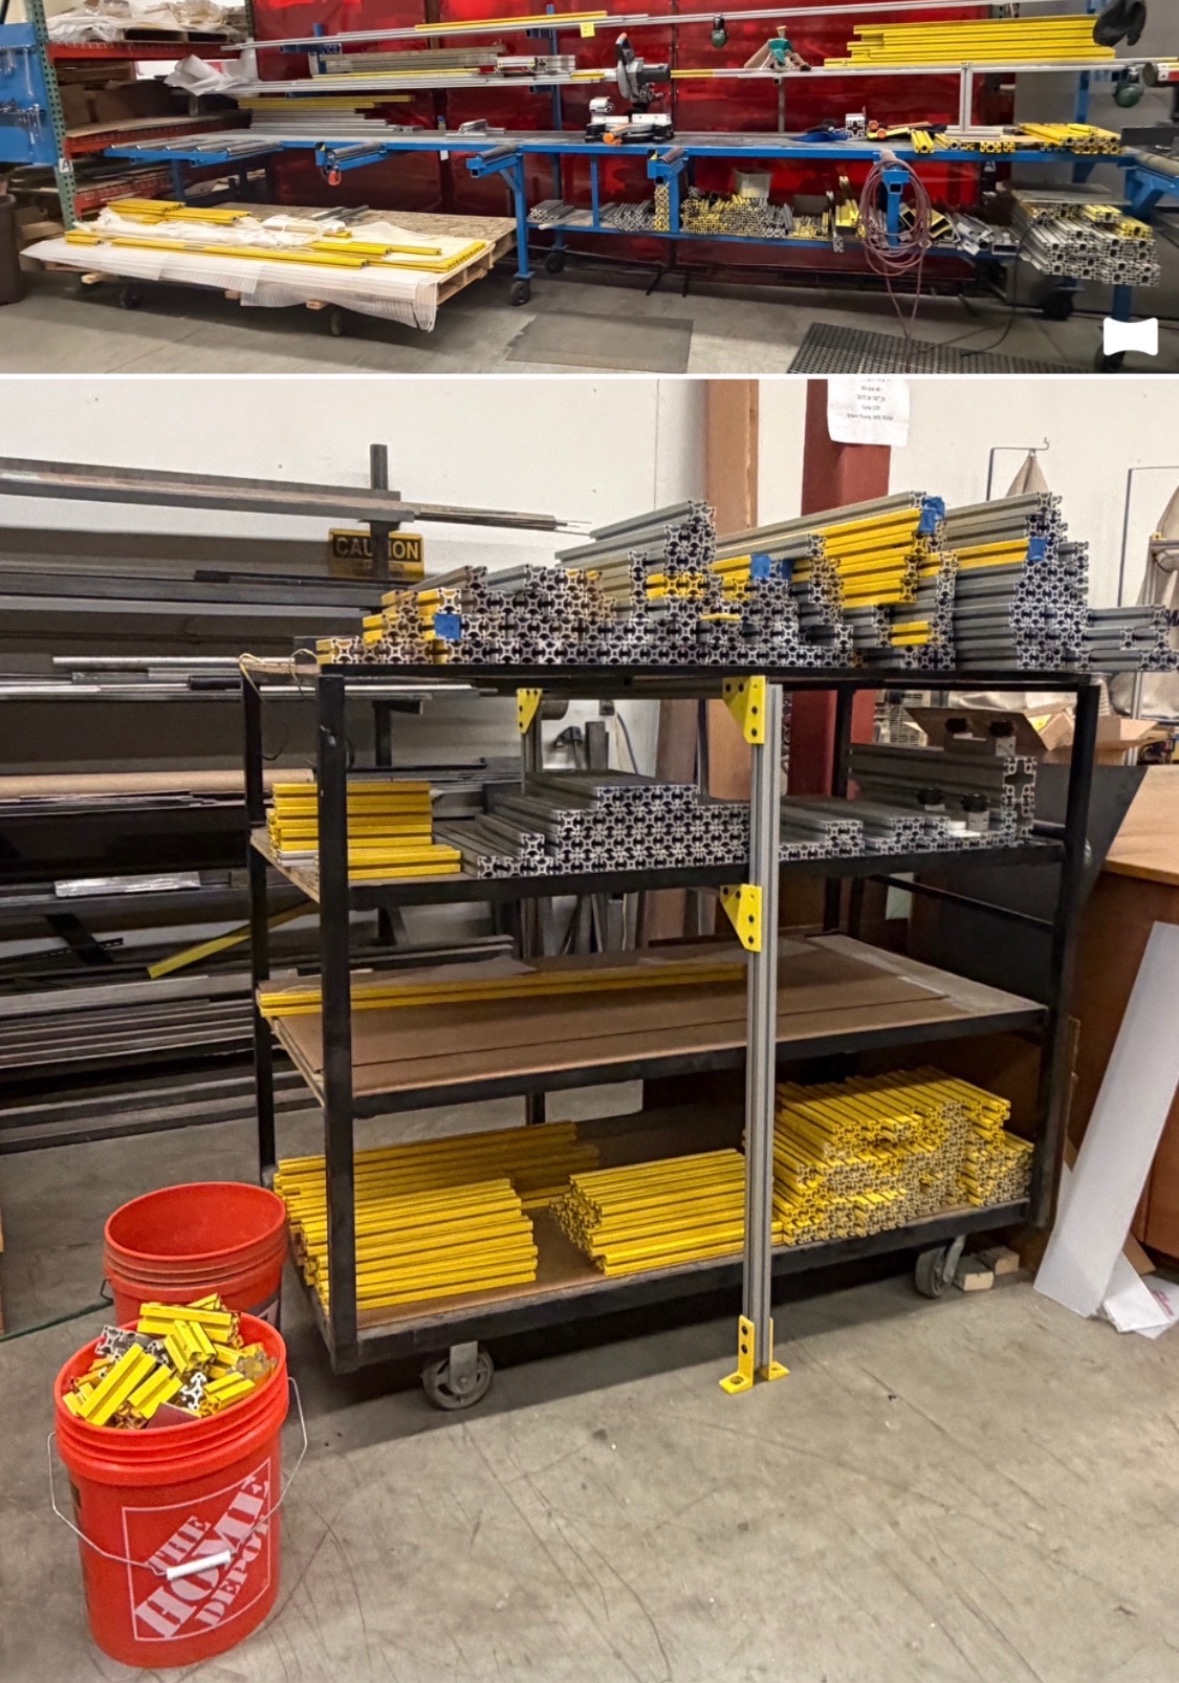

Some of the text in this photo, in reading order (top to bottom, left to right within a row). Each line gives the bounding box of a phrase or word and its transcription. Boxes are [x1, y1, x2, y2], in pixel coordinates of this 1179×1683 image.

[336, 537, 418, 560] CAUION
[135, 1475, 271, 1638] HOME
[148, 1515, 212, 1569] THE
